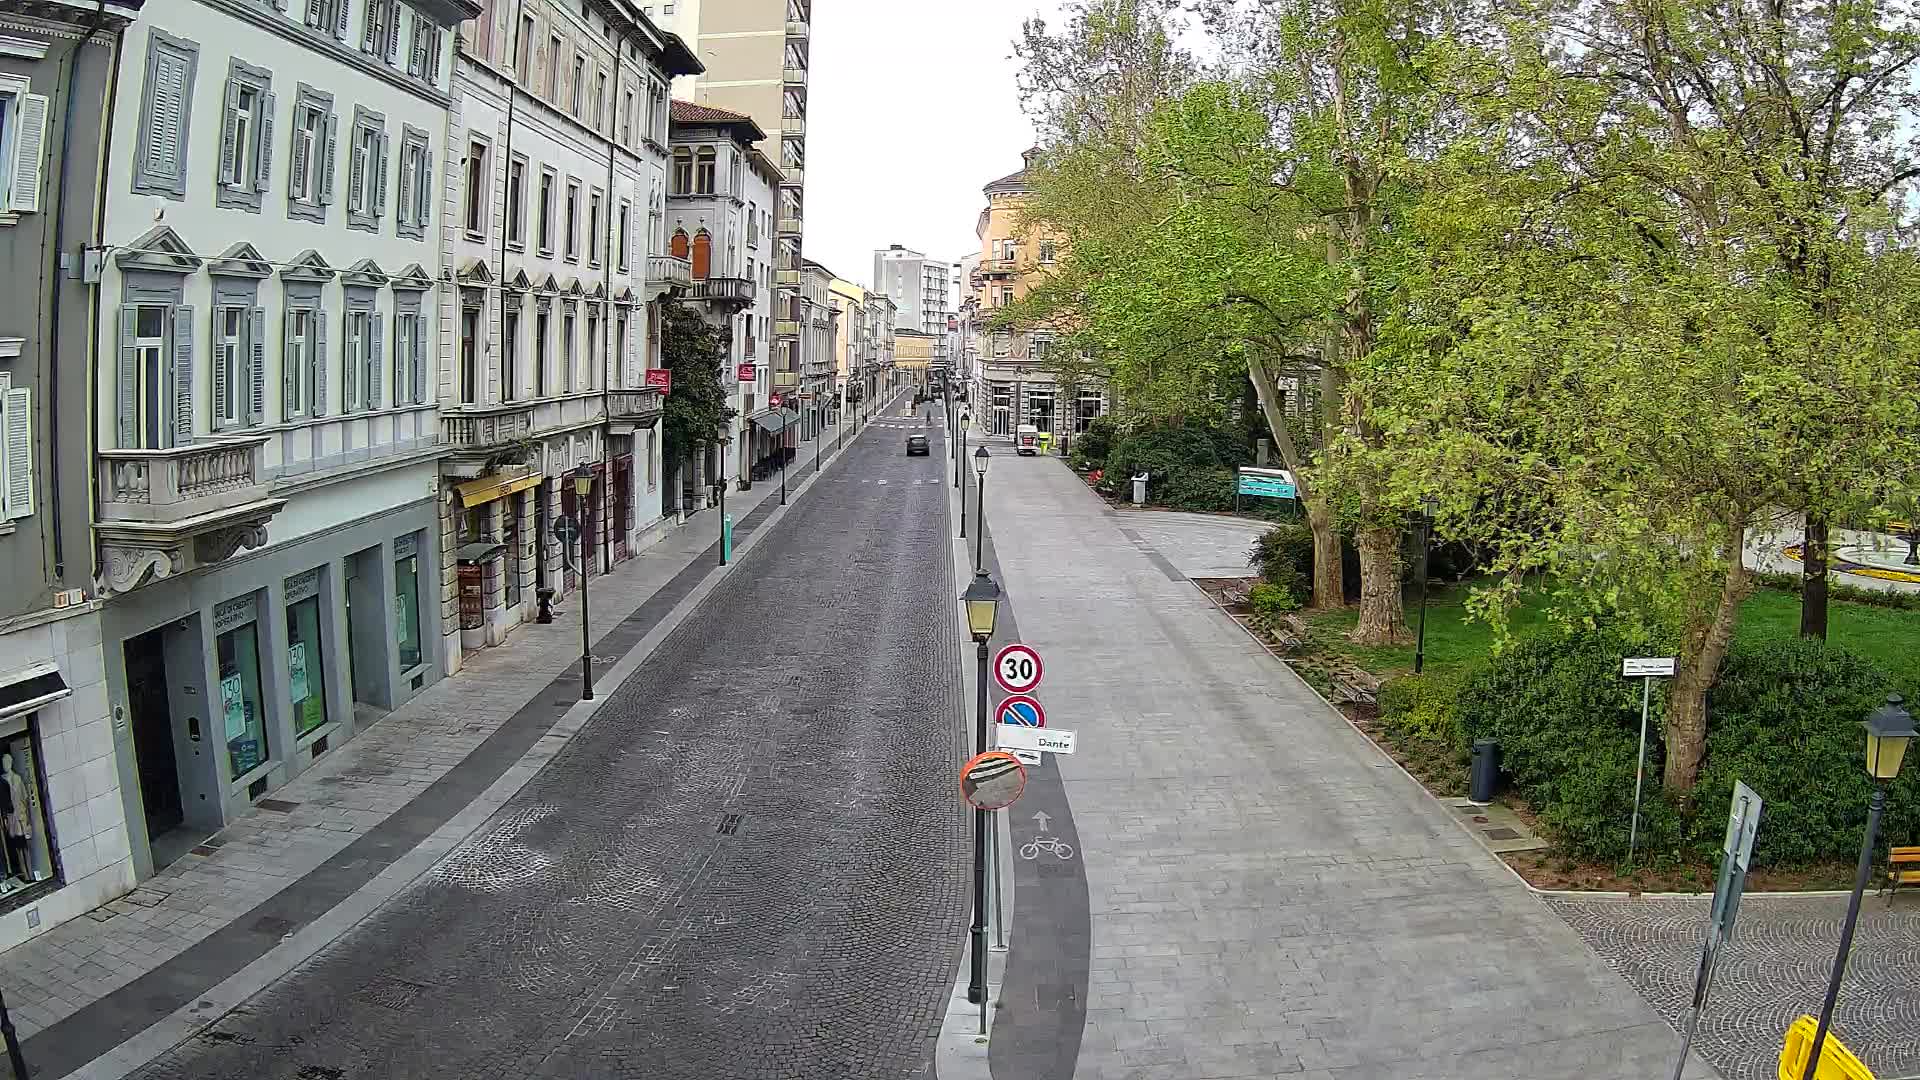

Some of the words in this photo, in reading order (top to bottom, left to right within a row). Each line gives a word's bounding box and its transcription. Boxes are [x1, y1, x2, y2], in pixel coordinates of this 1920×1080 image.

[1005, 658, 1033, 680] 30
[222, 677, 241, 700] 130
[1038, 738, 1070, 749] Dante
